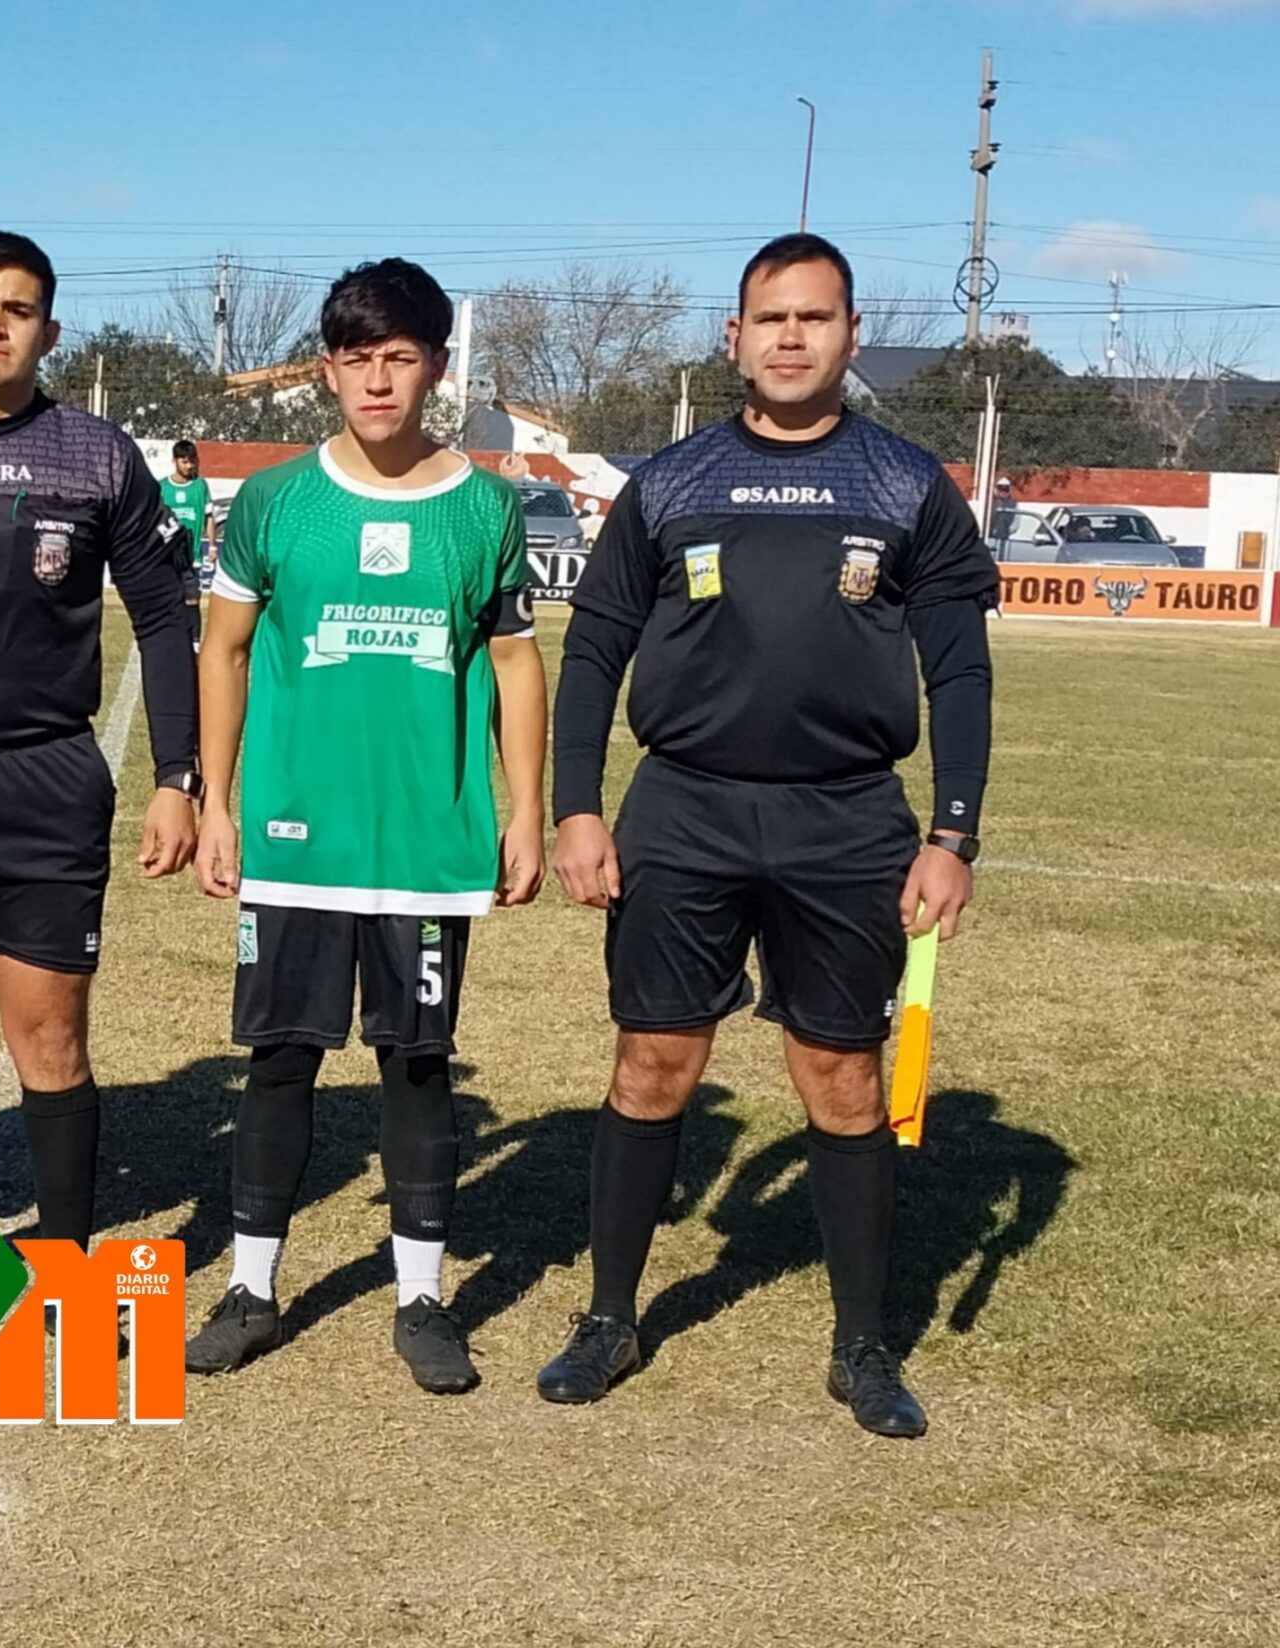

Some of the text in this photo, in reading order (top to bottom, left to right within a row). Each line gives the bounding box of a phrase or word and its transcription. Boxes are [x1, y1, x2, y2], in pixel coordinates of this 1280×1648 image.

[749, 487, 835, 503] SADRA
[1000, 576, 1260, 611] TORO TAURO
[321, 604, 448, 625] FRIGORIFICO
[345, 629, 420, 648] ROJAS
[415, 950, 443, 1006] 5
